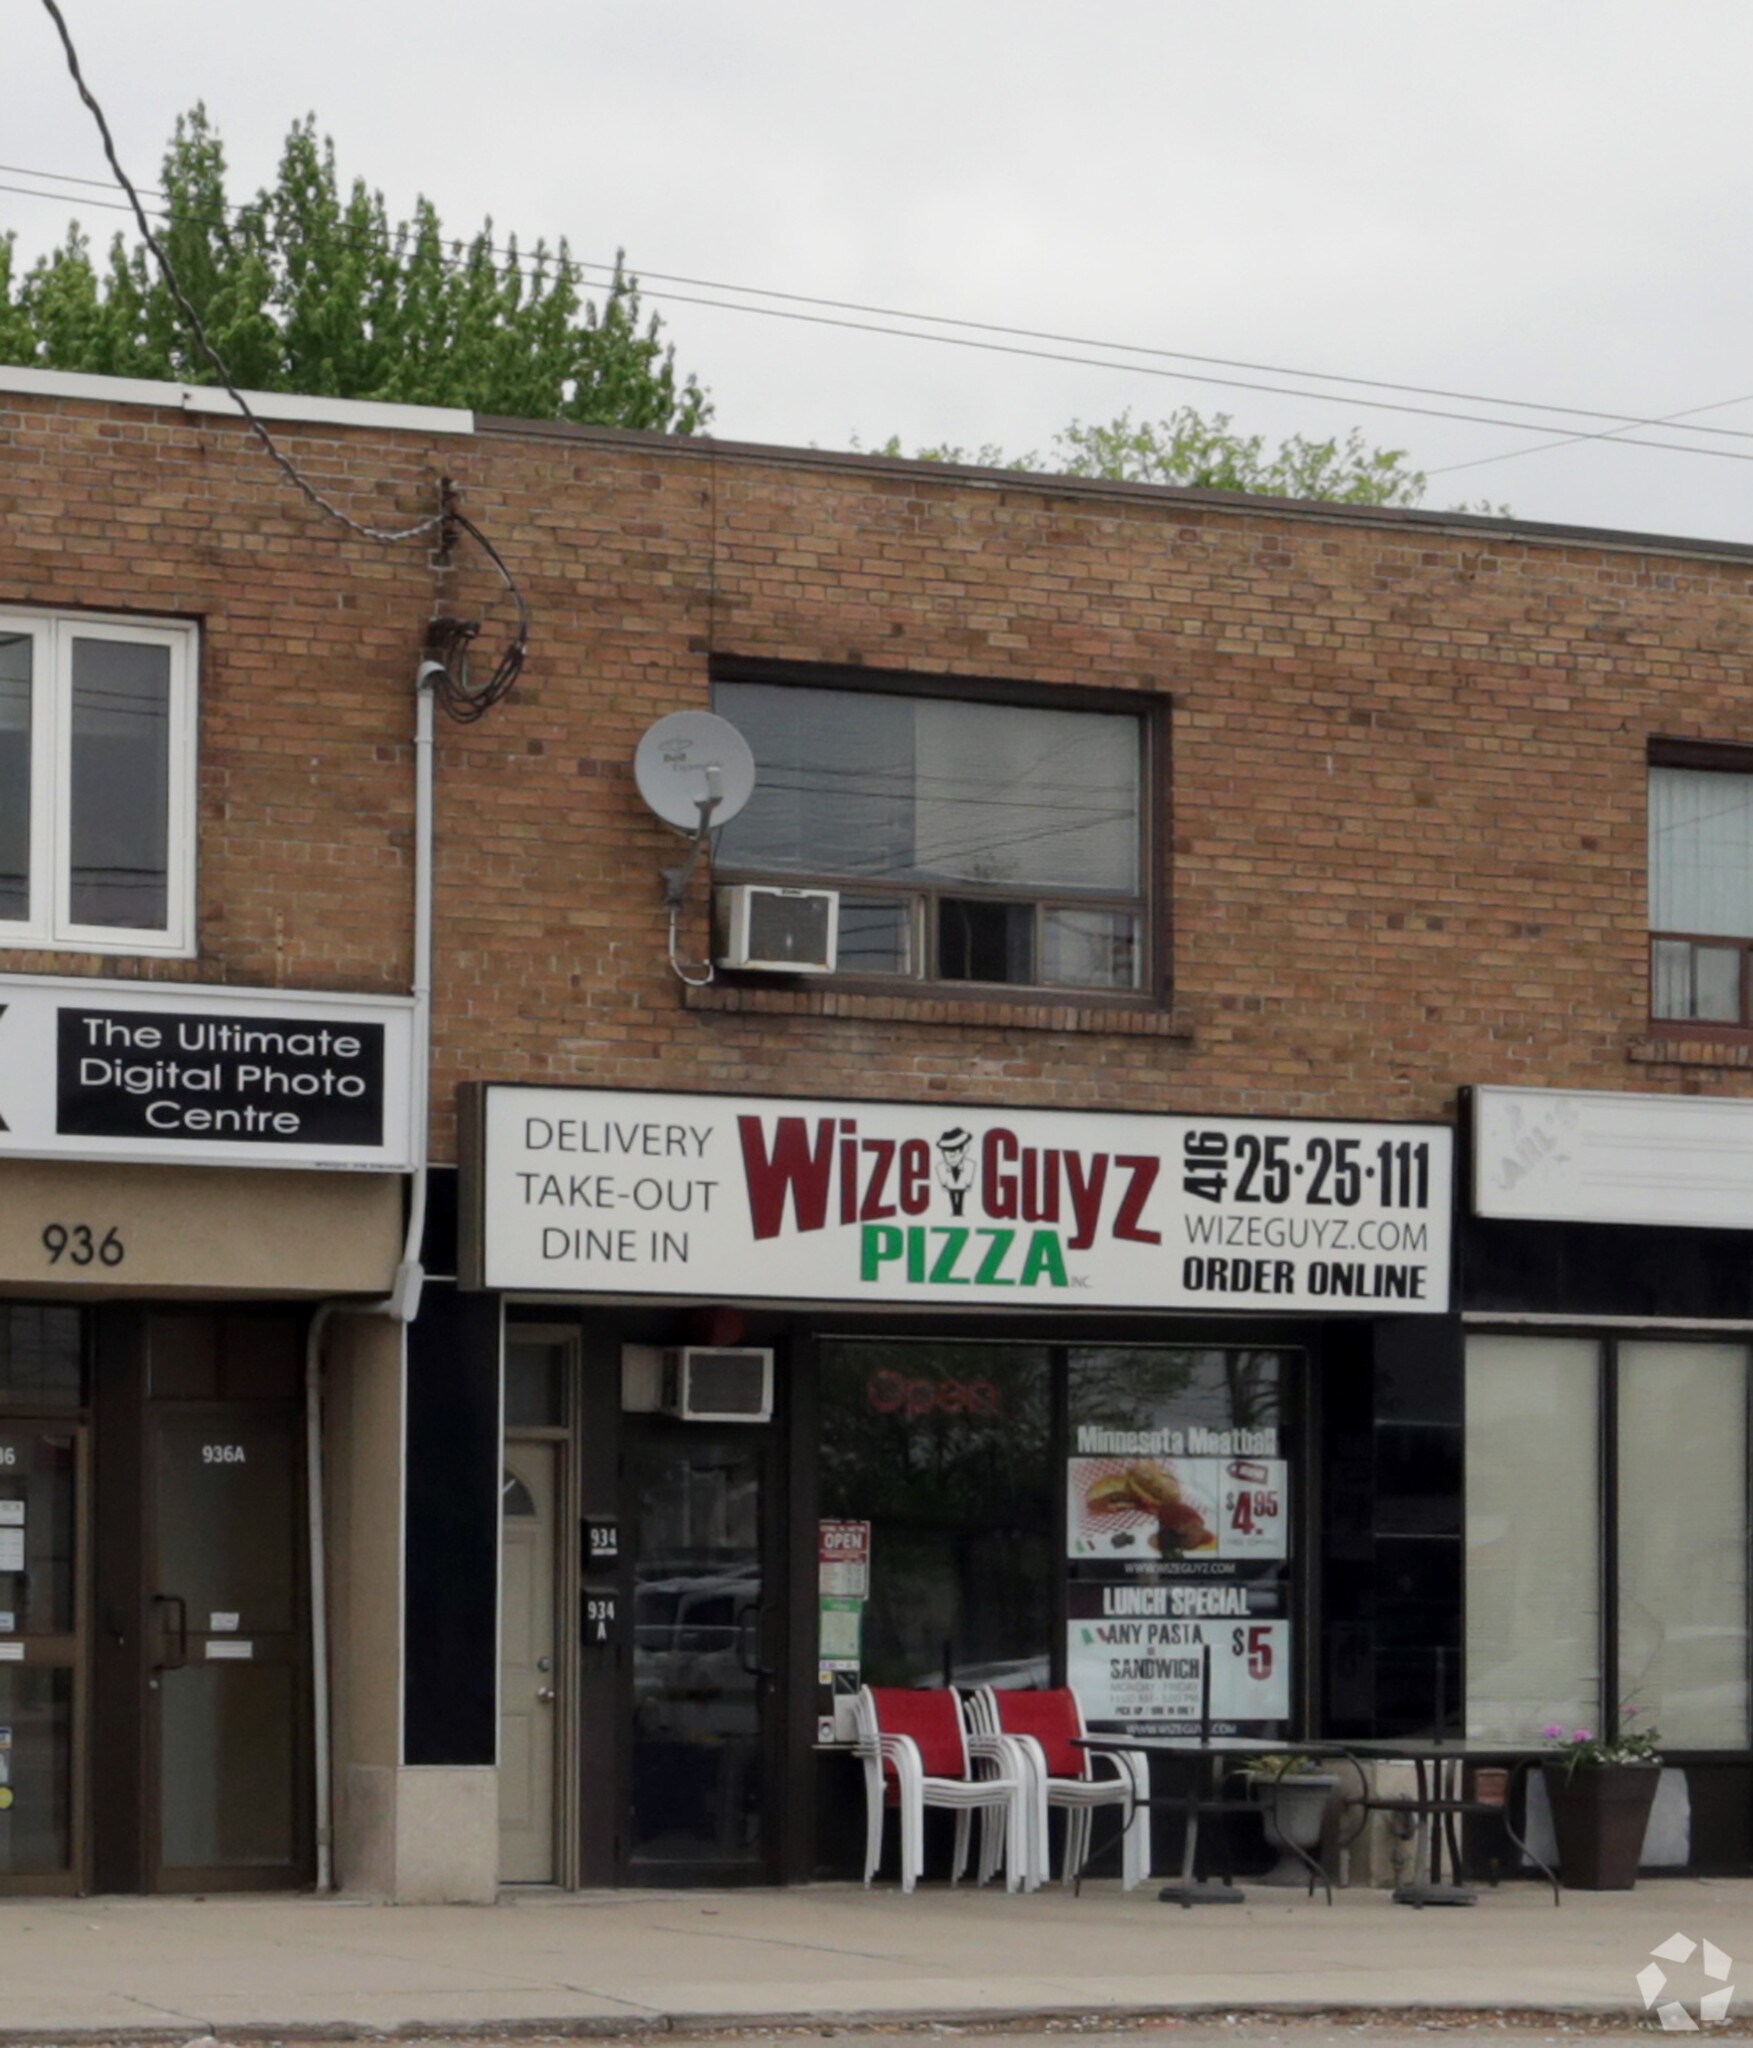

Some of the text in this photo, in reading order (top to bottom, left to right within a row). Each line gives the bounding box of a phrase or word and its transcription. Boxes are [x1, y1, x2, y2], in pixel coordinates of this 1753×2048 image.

[83, 1018, 362, 1058] The Ultimate
[79, 1058, 367, 1098] Digital Photo
[145, 1100, 301, 1134] Centre
[525, 1117, 714, 1158] DELIVERY
[1183, 1130, 1229, 1204] 416
[515, 1171, 720, 1213] TAKE-OUT
[42, 1222, 124, 1266] 936
[542, 1226, 690, 1263] DINE IN
[1184, 1213, 1428, 1252] WIZEGUYZ.COM
[859, 1223, 1070, 1288] PIZZA
[1182, 1255, 1428, 1300] ORDER ONLINE
[202, 1445, 246, 1463] 936A
[590, 1528, 617, 1547] 934
[824, 1532, 863, 1549] OPEN
[588, 1601, 615, 1620] 934
[1103, 1586, 1251, 1616] LUNCH SPECIAL
[597, 1621, 607, 1640] A
[1108, 1623, 1204, 1645] ANY PASTA
[1110, 1658, 1200, 1680] SANDWICH
[1232, 1625, 1274, 1681] $5
